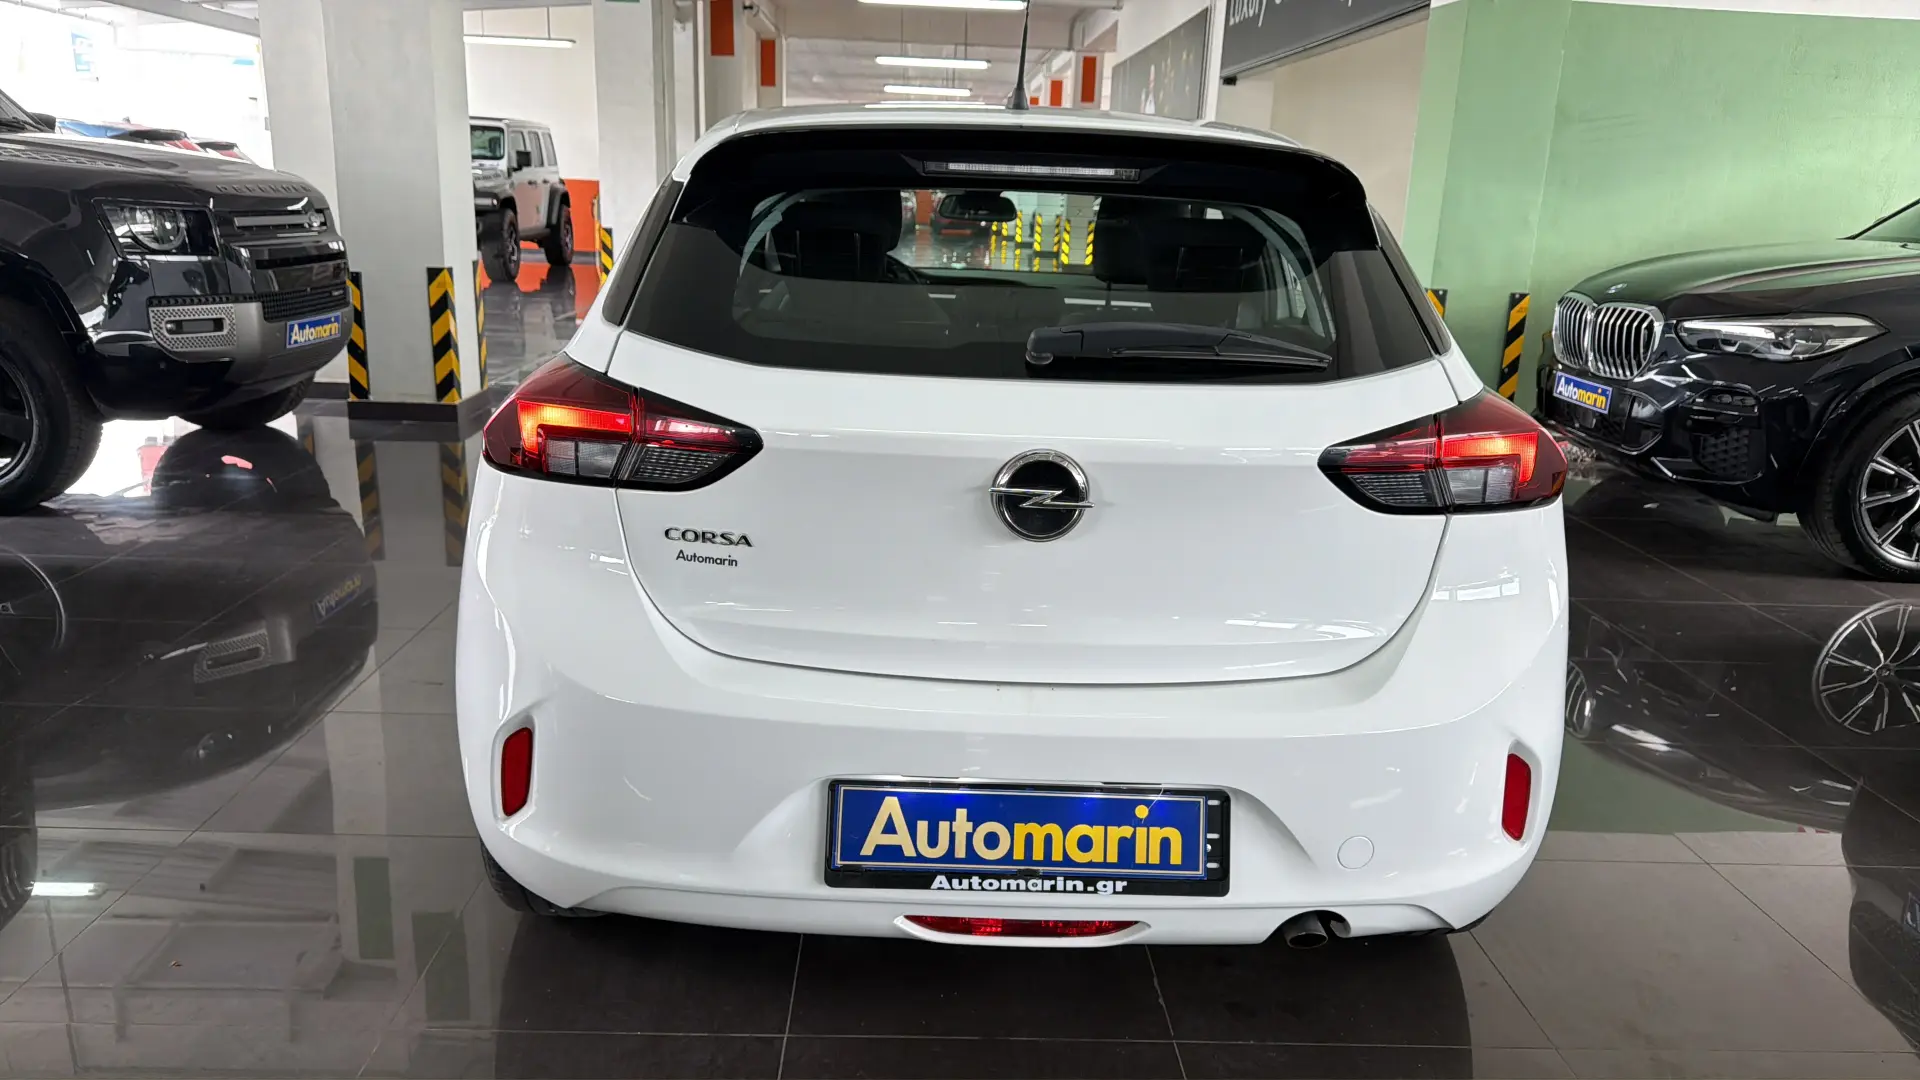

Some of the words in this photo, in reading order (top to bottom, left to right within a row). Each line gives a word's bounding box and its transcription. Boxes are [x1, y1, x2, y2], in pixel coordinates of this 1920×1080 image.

[289, 316, 340, 345] Automarin
[1556, 376, 1607, 410] Automarin
[664, 527, 753, 547] CORSA
[676, 549, 738, 567] Automarin
[859, 796, 1183, 865] Automarin
[930, 874, 1128, 895] Automarin.gr
